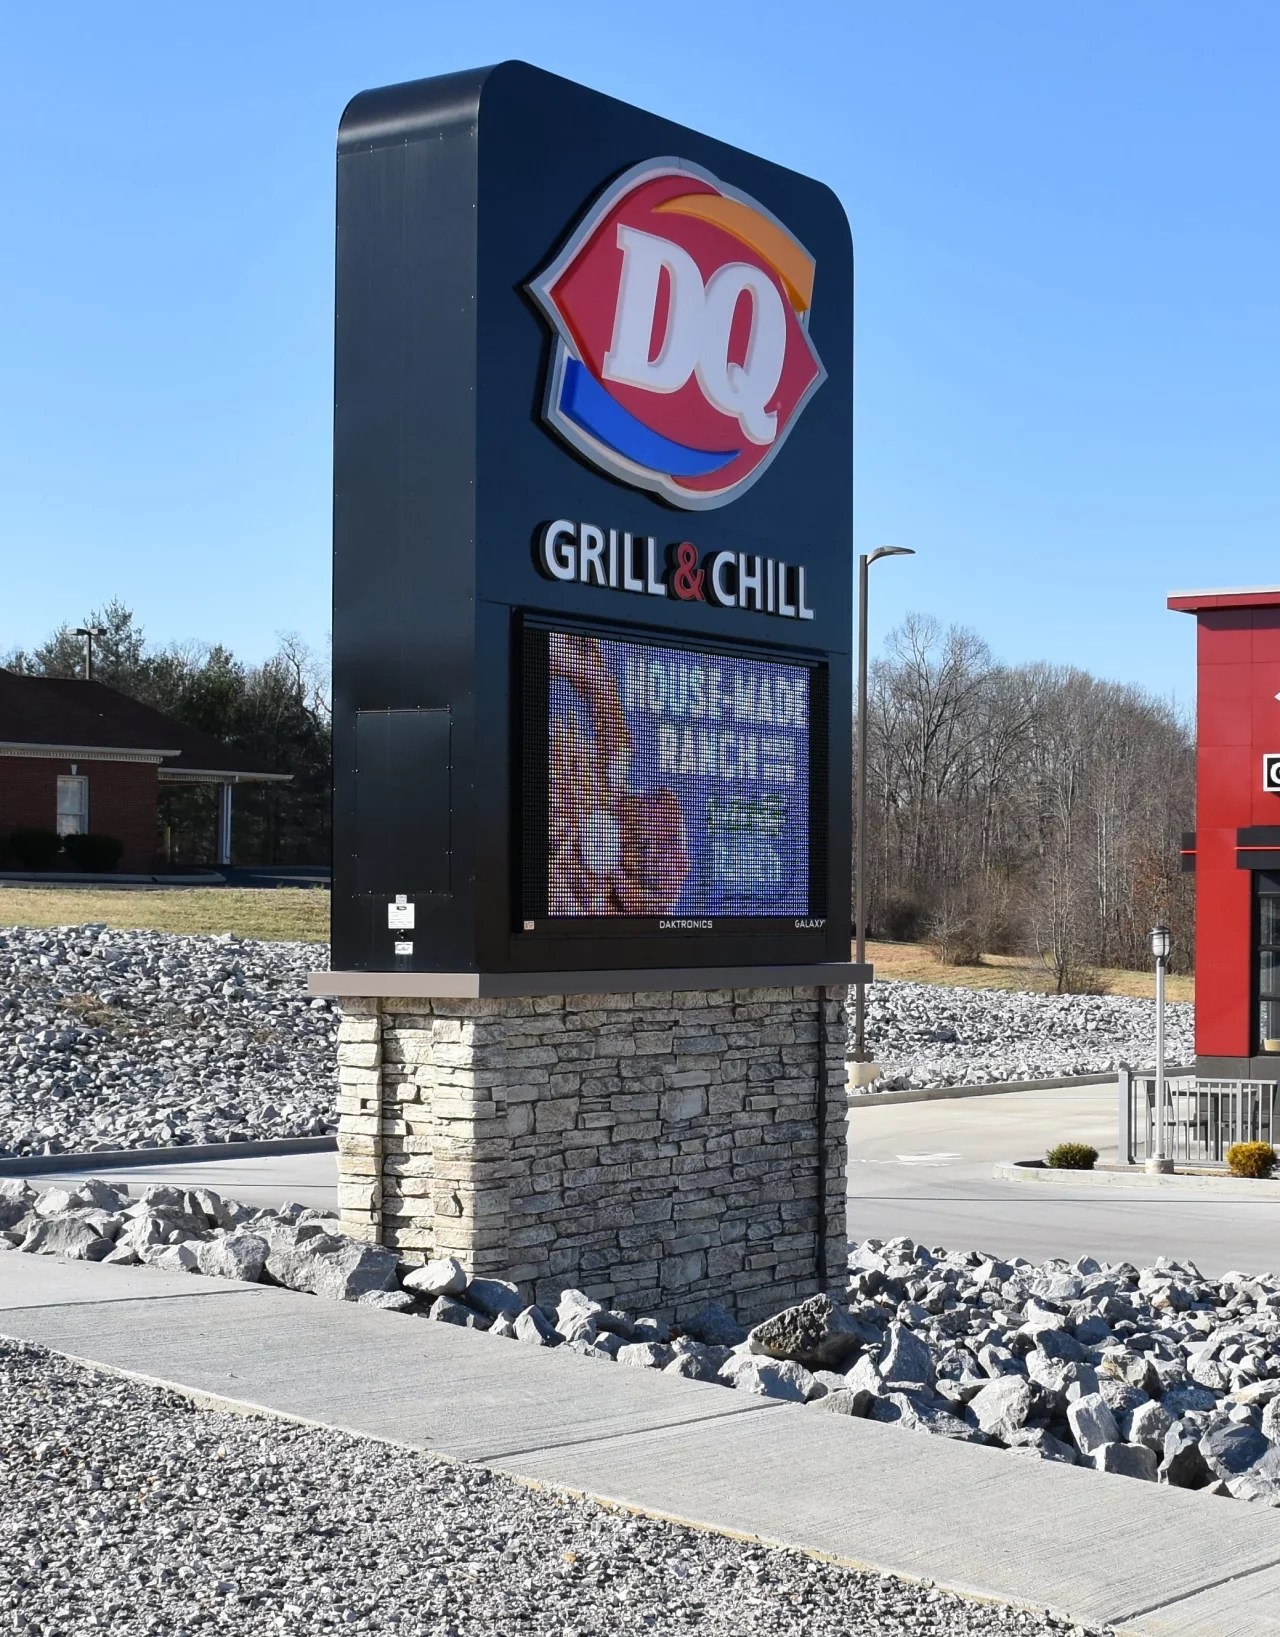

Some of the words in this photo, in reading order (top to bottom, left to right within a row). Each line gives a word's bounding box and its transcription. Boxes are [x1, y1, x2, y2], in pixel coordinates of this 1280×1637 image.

[601, 222, 787, 447] DQ
[544, 518, 667, 598] GRILL
[673, 541, 705, 601] &
[711, 550, 815, 620] CHILL
[659, 920, 713, 929] DAKTRONICS
[794, 919, 824, 929] GALAXY
